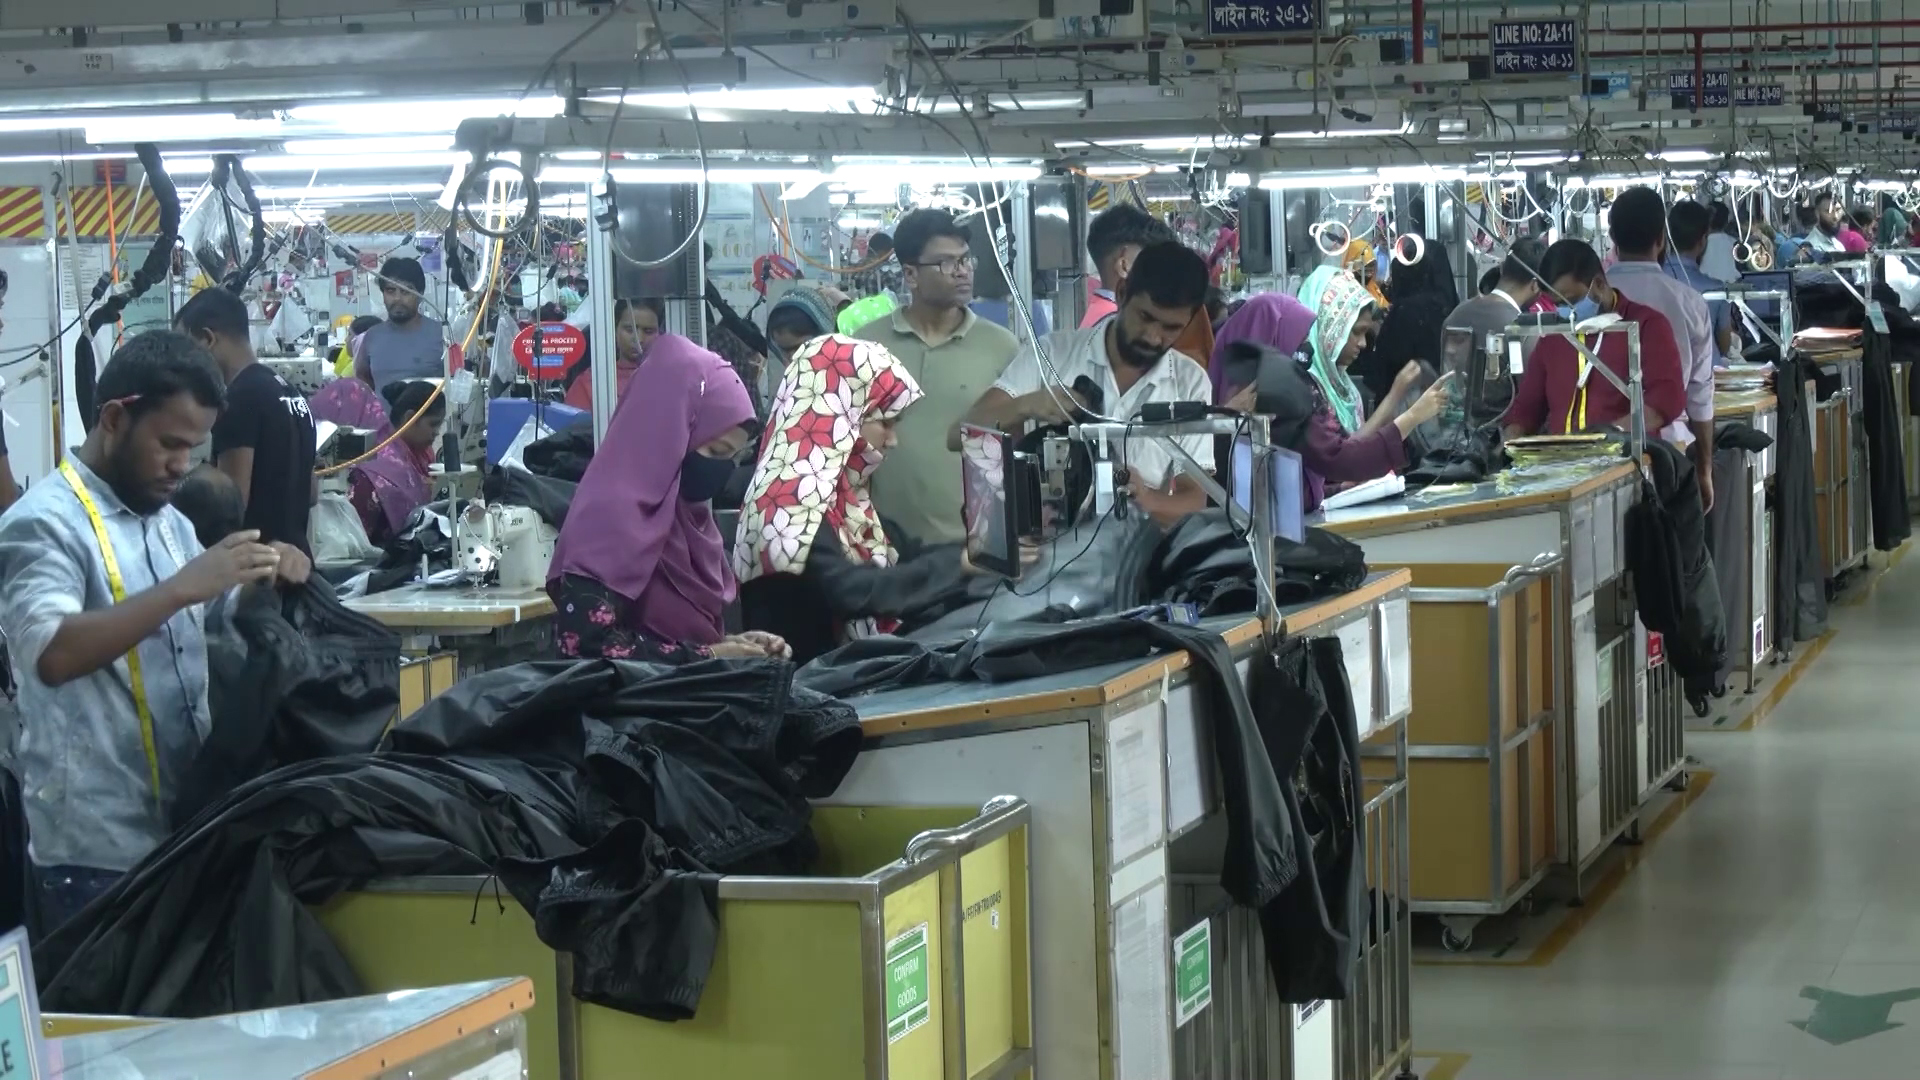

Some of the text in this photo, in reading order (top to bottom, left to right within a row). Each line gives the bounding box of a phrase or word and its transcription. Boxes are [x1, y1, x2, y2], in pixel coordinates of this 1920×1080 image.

[1214, 1, 1247, 29] লাইন
[1275, 3, 1320, 27] ২এ-১
[1494, 23, 1573, 44] LINE NO: 2A-11
[1496, 51, 1520, 71] লাইন
[1670, 73, 1728, 88] LINE N: 2A-10
[894, 955, 919, 982] CONFIRM
[897, 985, 918, 1008] GOODS
